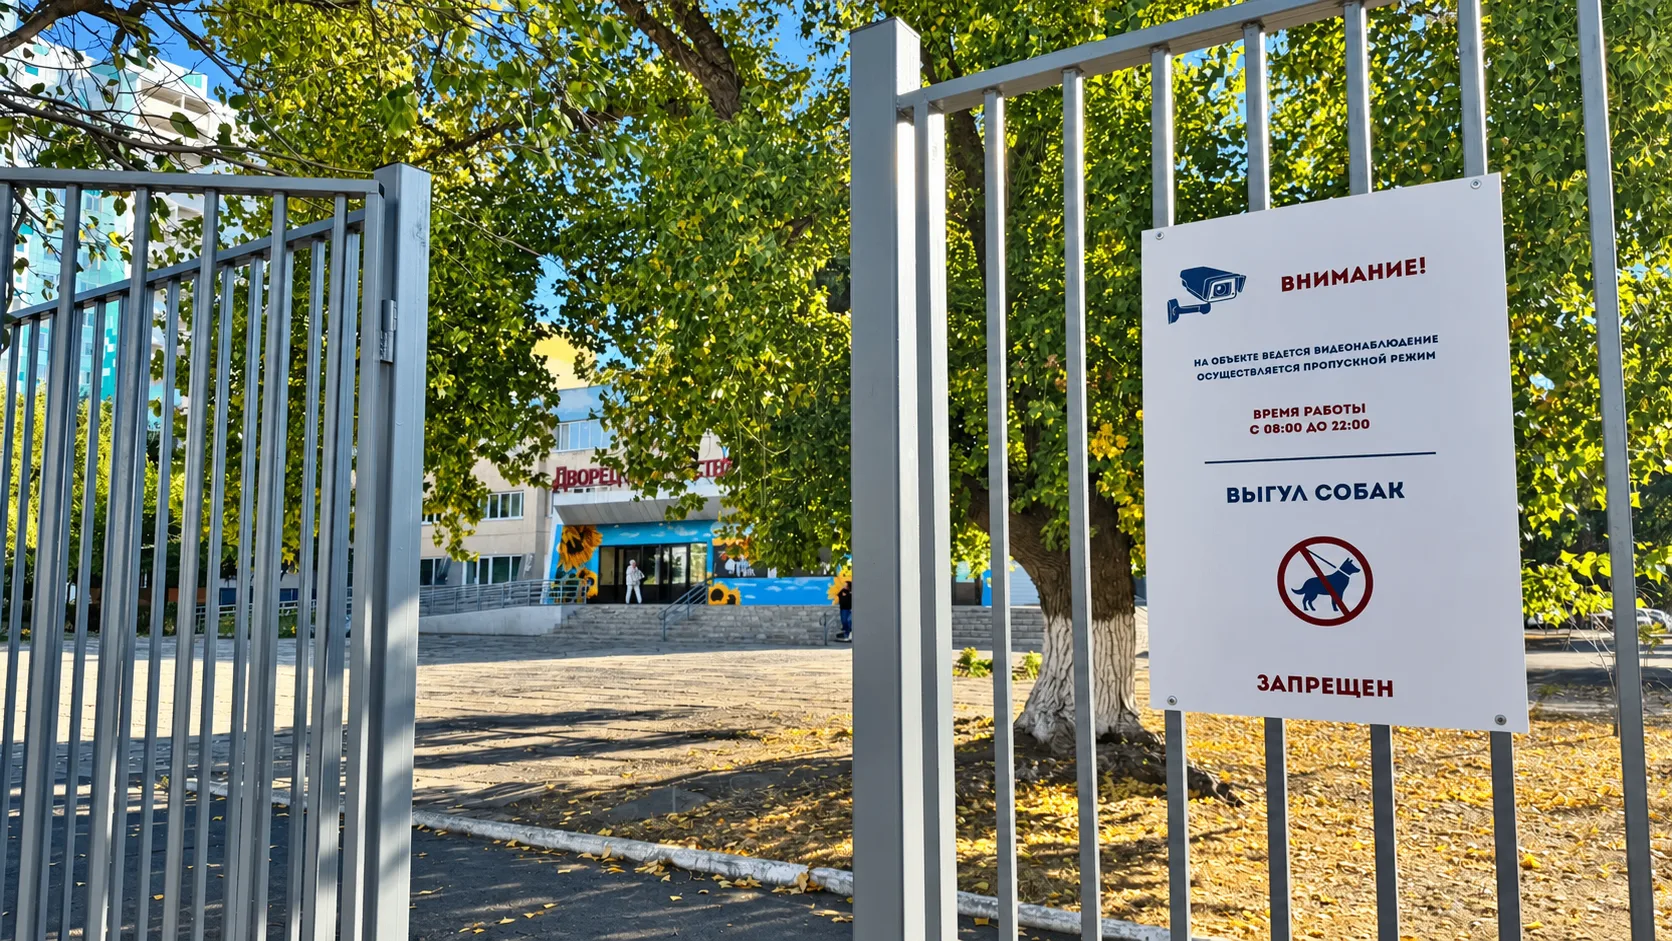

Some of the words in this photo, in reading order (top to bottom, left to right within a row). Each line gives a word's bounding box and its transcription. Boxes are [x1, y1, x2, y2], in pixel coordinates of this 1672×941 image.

[1281, 256, 1426, 293] ВНИМАНИЕ!
[1193, 358, 1210, 368] НА
[1211, 351, 1260, 367] ОБЪЕКТЕ
[1262, 346, 1311, 361] ВЕДЕТСЯ
[1313, 334, 1439, 356] ВИДЕОНАБЛЮДЕНИЕ
[1196, 361, 1301, 382] ОСУЩЕСТВЛЯЕТСЯ
[1303, 352, 1387, 372] ПРОПУСКНОЙ
[1390, 350, 1437, 365] РЕЖИМ
[1253, 408, 1300, 420] ВРЕМЯ
[1303, 402, 1366, 417] РАБОТЫ
[1249, 424, 1260, 435] С
[1263, 422, 1303, 434] 08:00
[1306, 420, 1328, 434] ДО
[1331, 418, 1371, 432] 22:00
[1226, 484, 1309, 504] ВЫГУЛ
[1314, 481, 1406, 502] СОБАК
[1256, 673, 1394, 699] ЗАПРЕЩЕН
